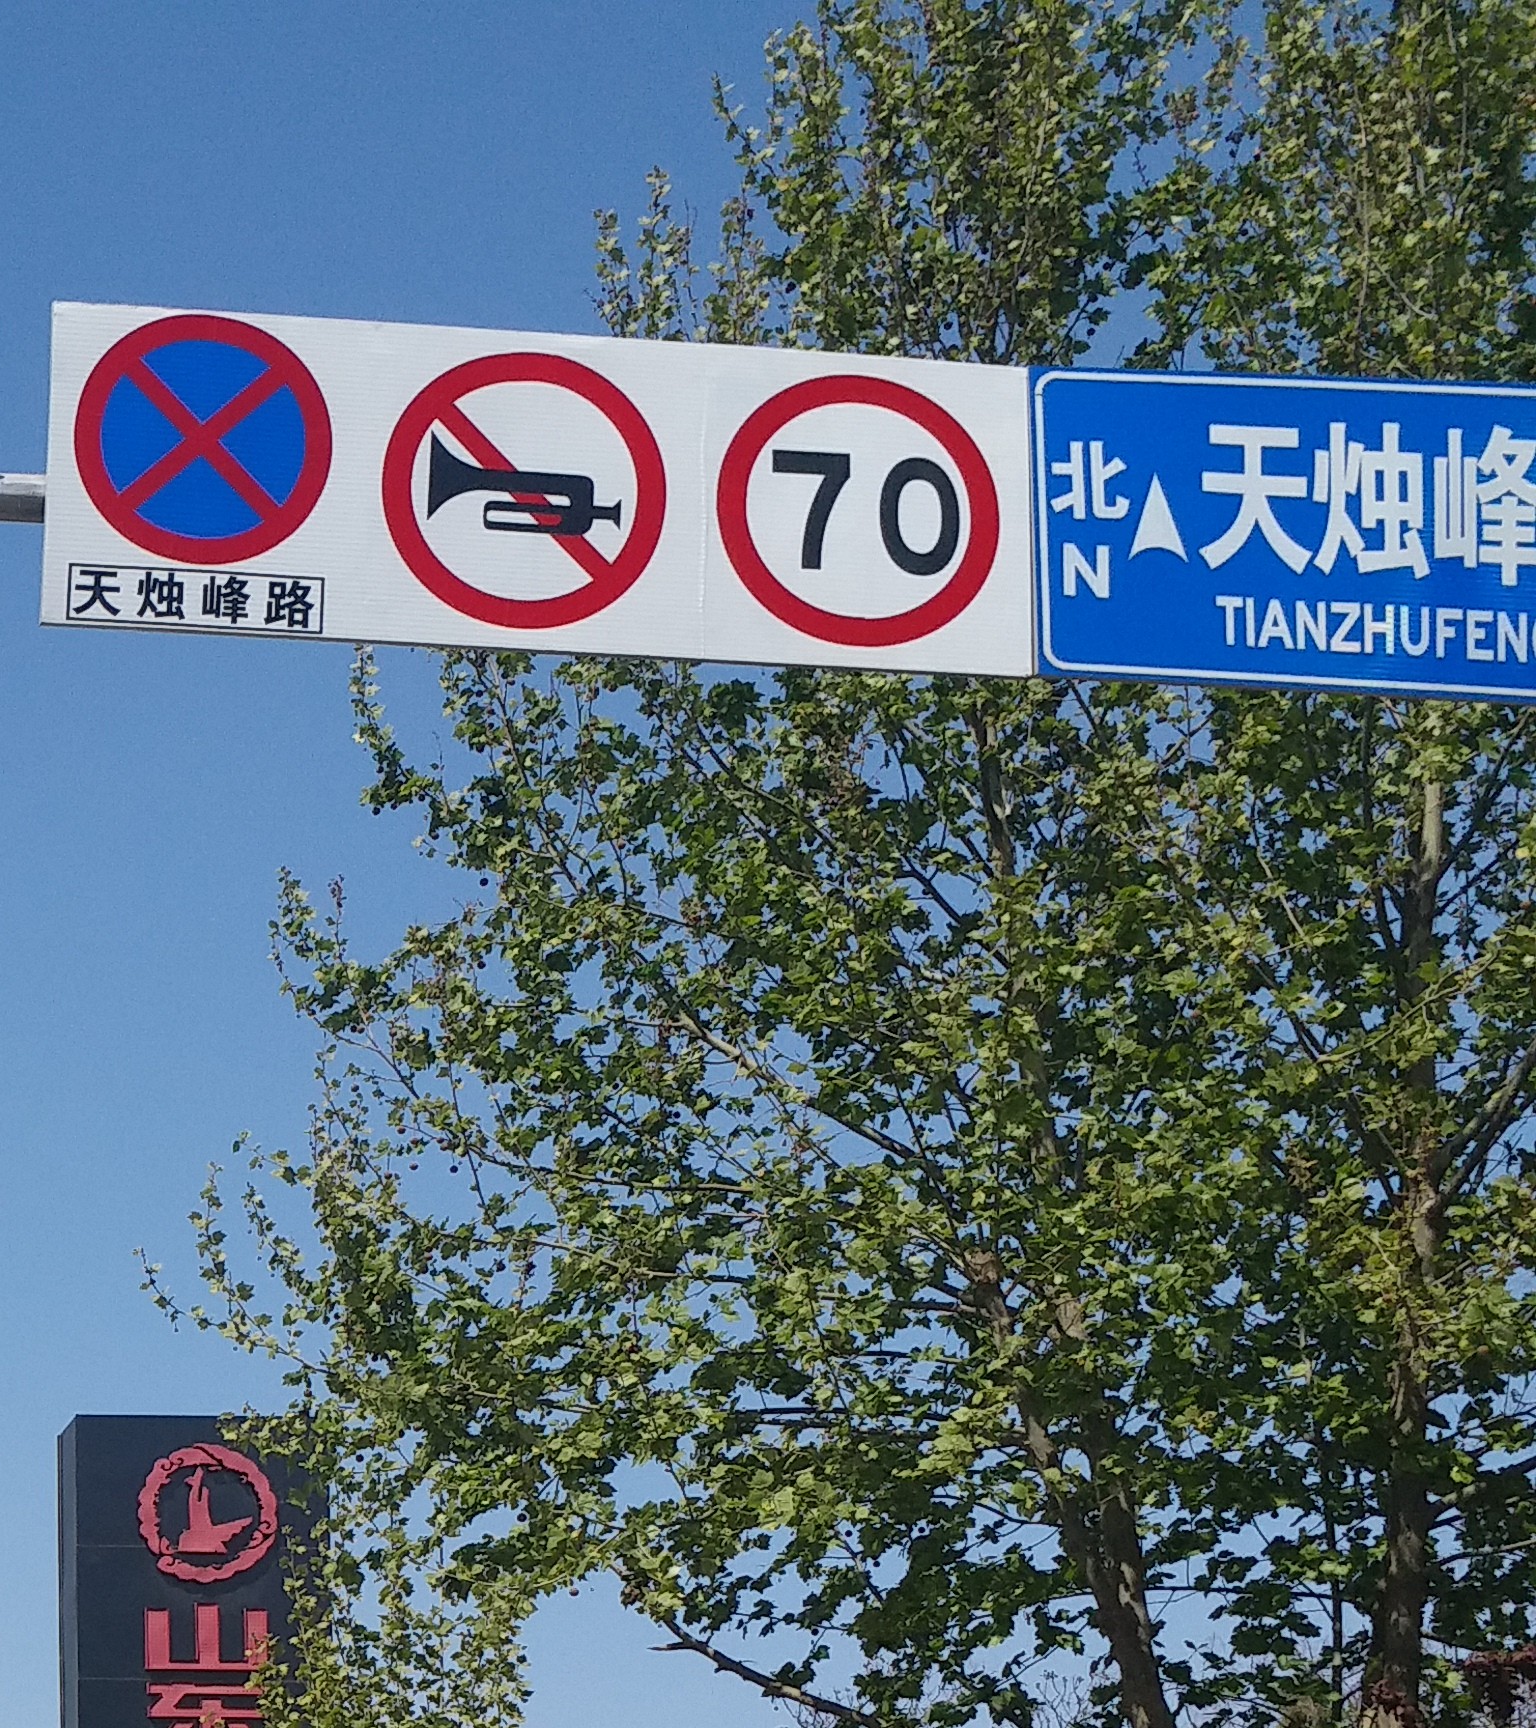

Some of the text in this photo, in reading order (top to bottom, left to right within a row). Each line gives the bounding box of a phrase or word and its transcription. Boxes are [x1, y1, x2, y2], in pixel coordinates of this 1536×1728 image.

[770, 448, 961, 577] 70
[1050, 440, 1131, 520] 北
[1198, 421, 1536, 586] 天烛峰
[72, 568, 315, 629] 天烛峰路
[1062, 541, 1111, 599] N
[1215, 594, 1536, 664] TIANZHUFEN
